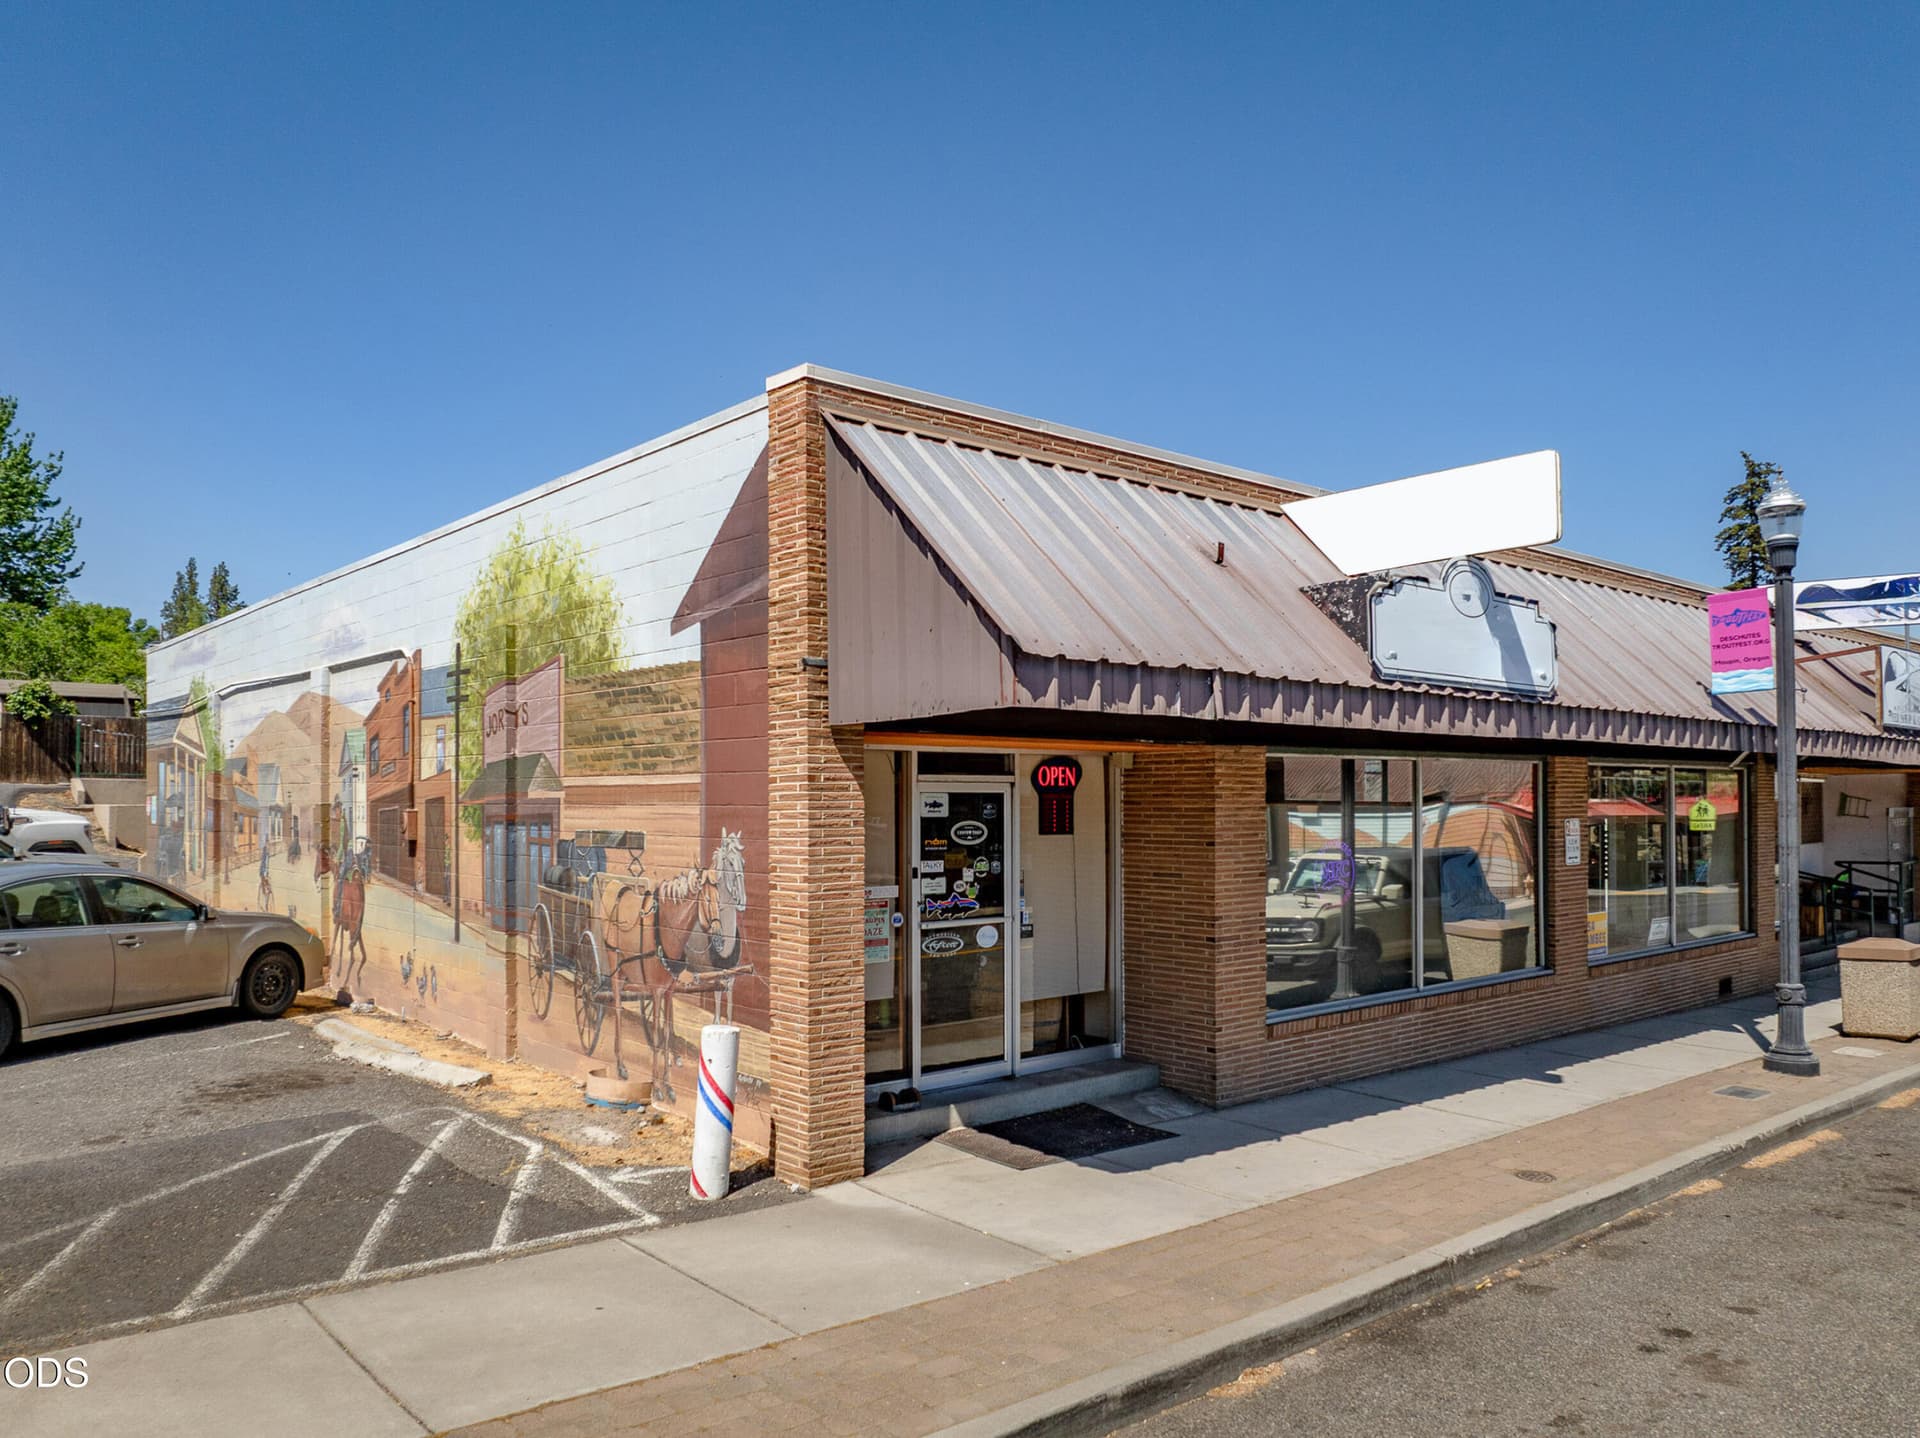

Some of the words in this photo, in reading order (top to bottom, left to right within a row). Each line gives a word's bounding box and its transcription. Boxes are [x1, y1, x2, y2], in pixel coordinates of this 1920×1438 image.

[1720, 632, 1761, 642] DESCHUTES
[1712, 639, 1770, 650] TROUTFEST.ORG
[1038, 765, 1076, 787] OPEN
